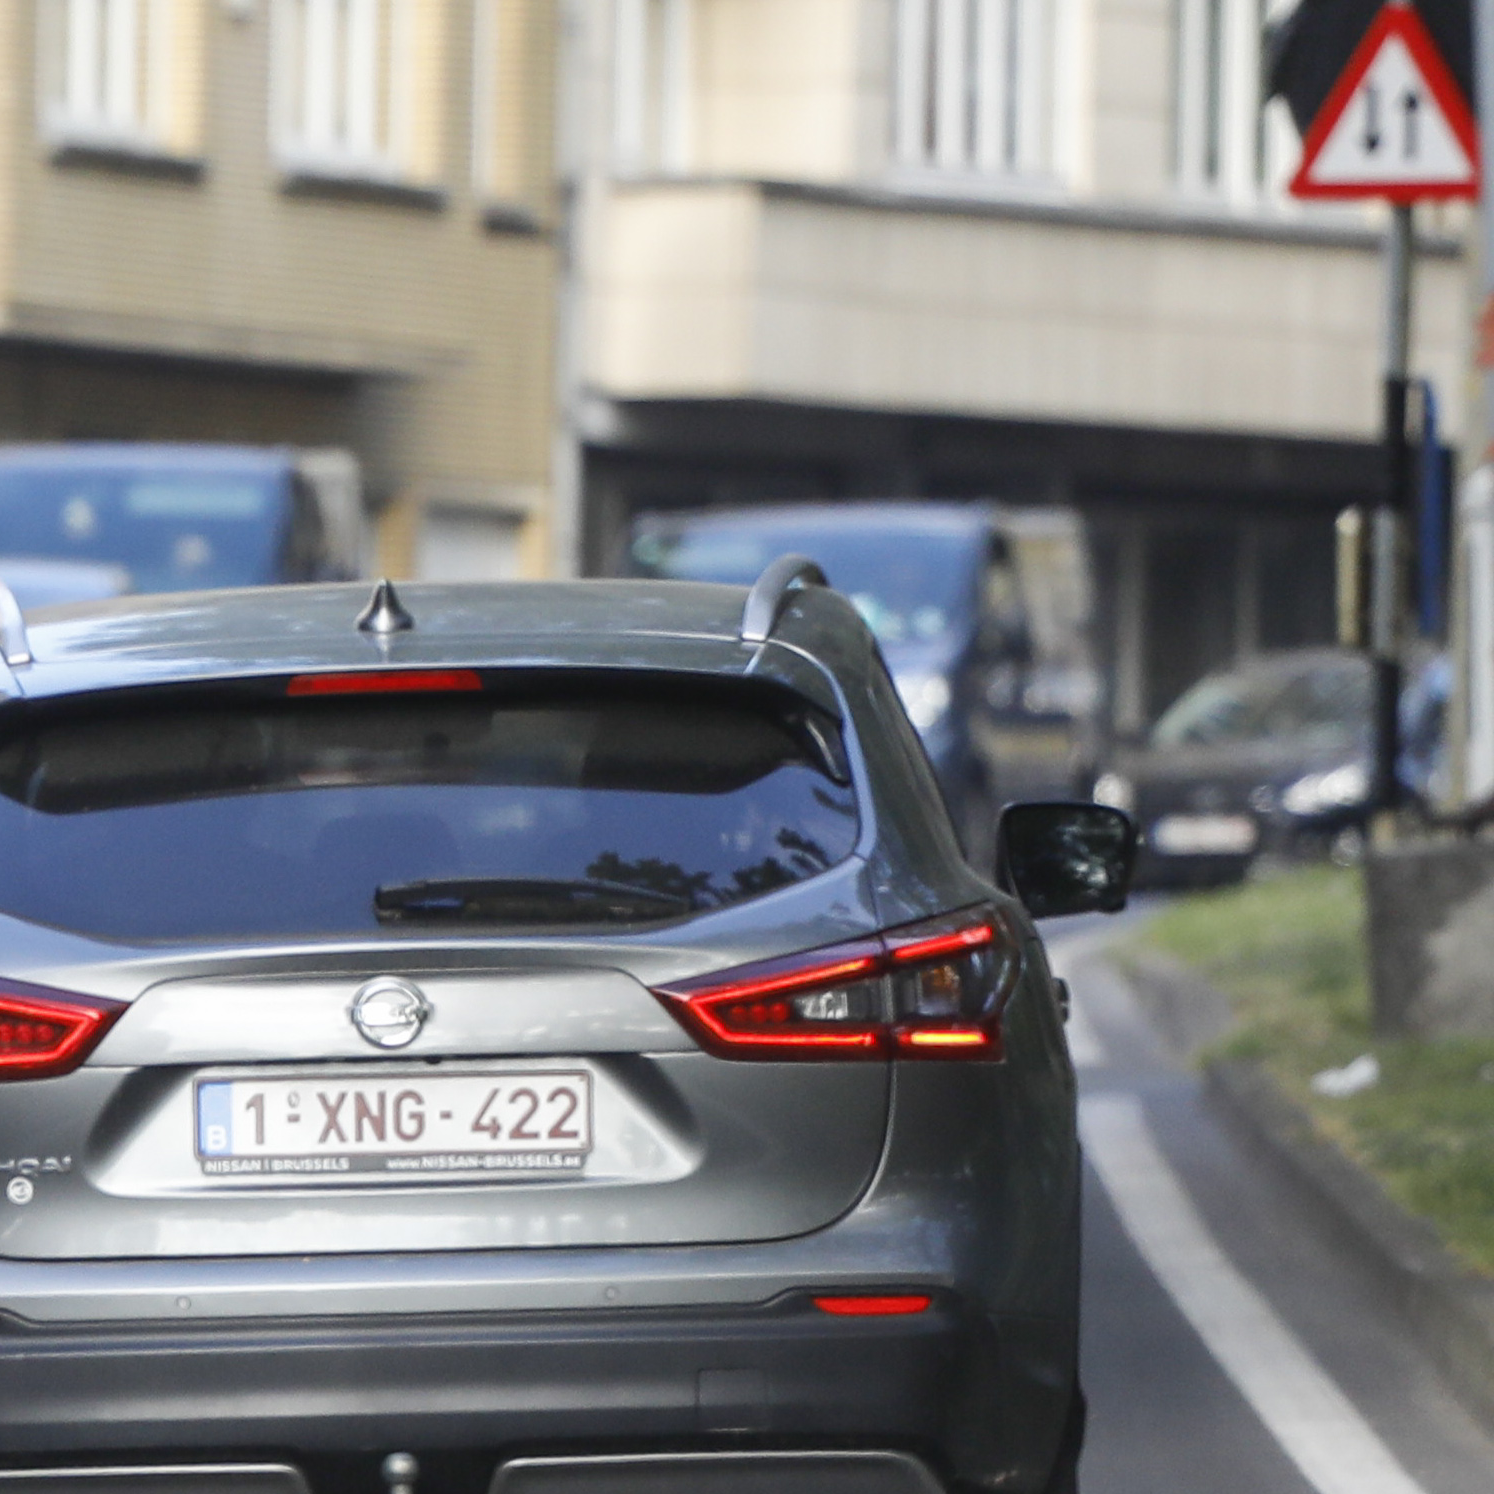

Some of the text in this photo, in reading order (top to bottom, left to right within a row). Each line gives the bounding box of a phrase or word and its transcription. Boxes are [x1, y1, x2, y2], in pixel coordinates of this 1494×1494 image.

[206, 1124, 228, 1150] B
[204, 1156, 351, 1173] NISSAN BRUSSELS
